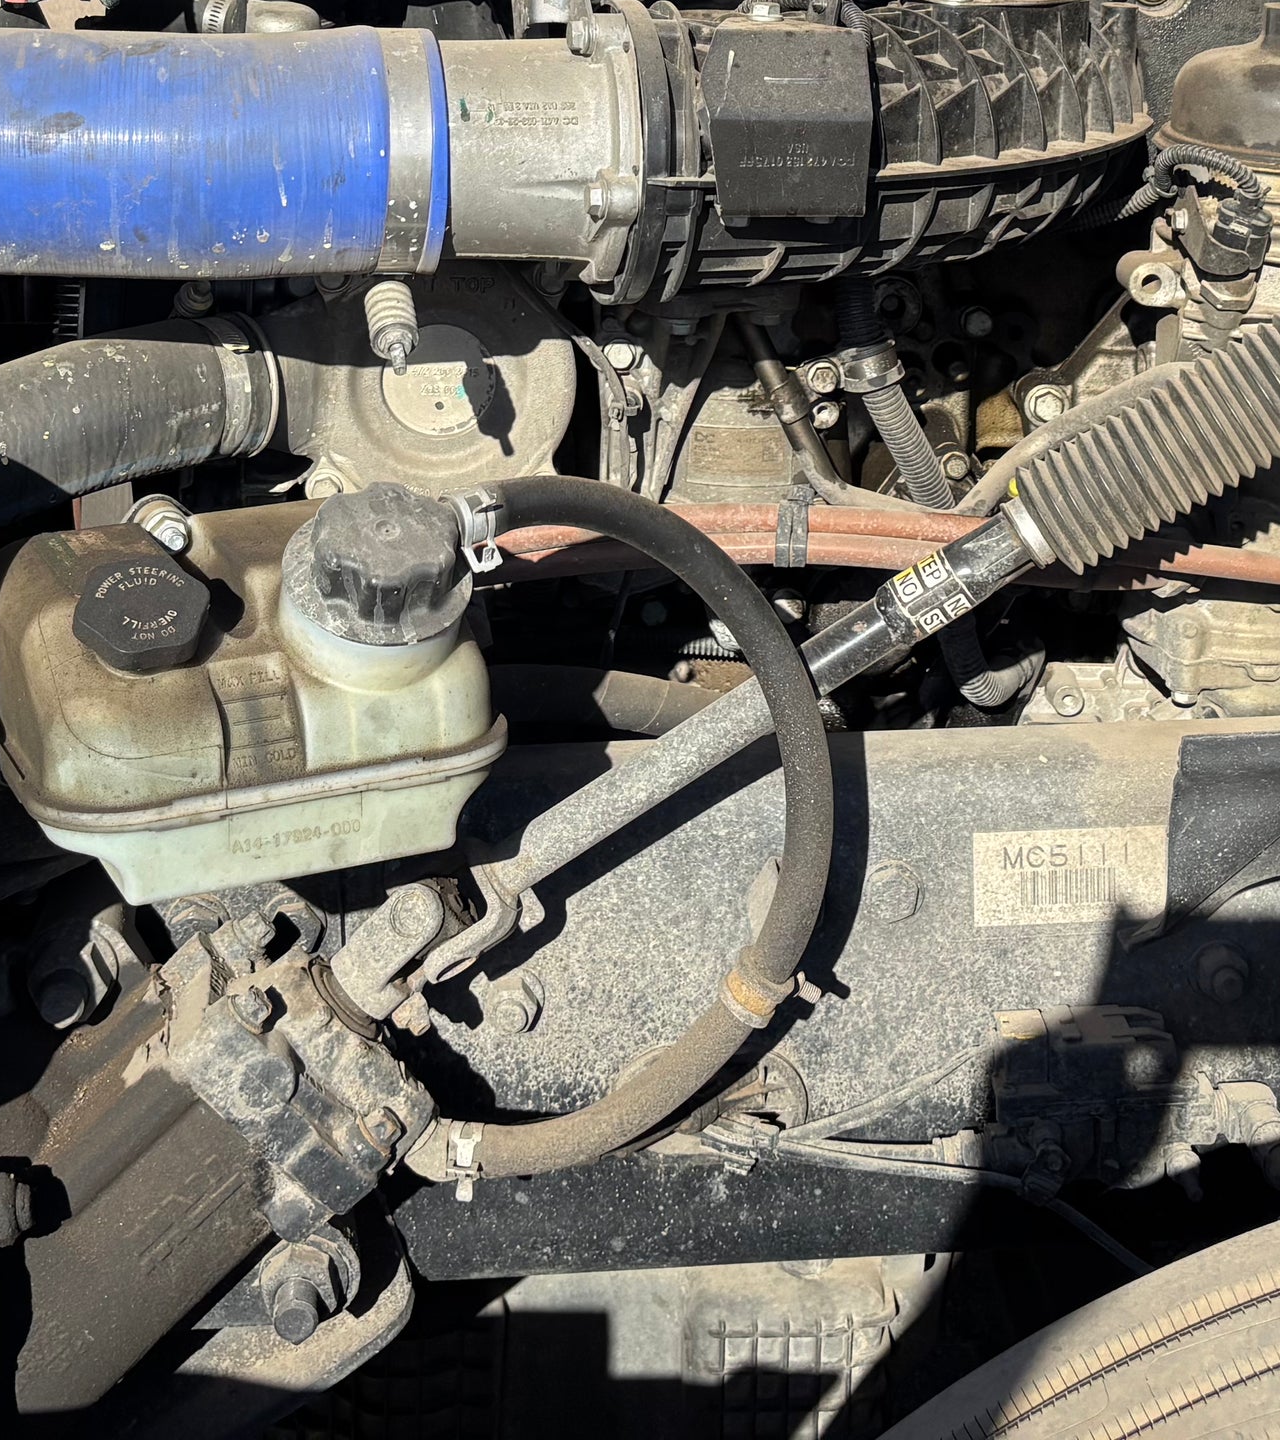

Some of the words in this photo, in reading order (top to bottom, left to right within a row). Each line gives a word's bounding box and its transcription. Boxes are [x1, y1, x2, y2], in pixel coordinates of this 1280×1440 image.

[919, 554, 942, 580] TEP
[95, 572, 123, 599] POWER
[128, 566, 185, 588] STEERING
[118, 577, 158, 592] FLUID
[897, 571, 918, 597] NO
[122, 609, 178, 630] OVERFILL
[924, 613, 945, 631] ST
[131, 632, 155, 640] NOT
[161, 625, 177, 637] DO
[266, 747, 297, 763] COLD
